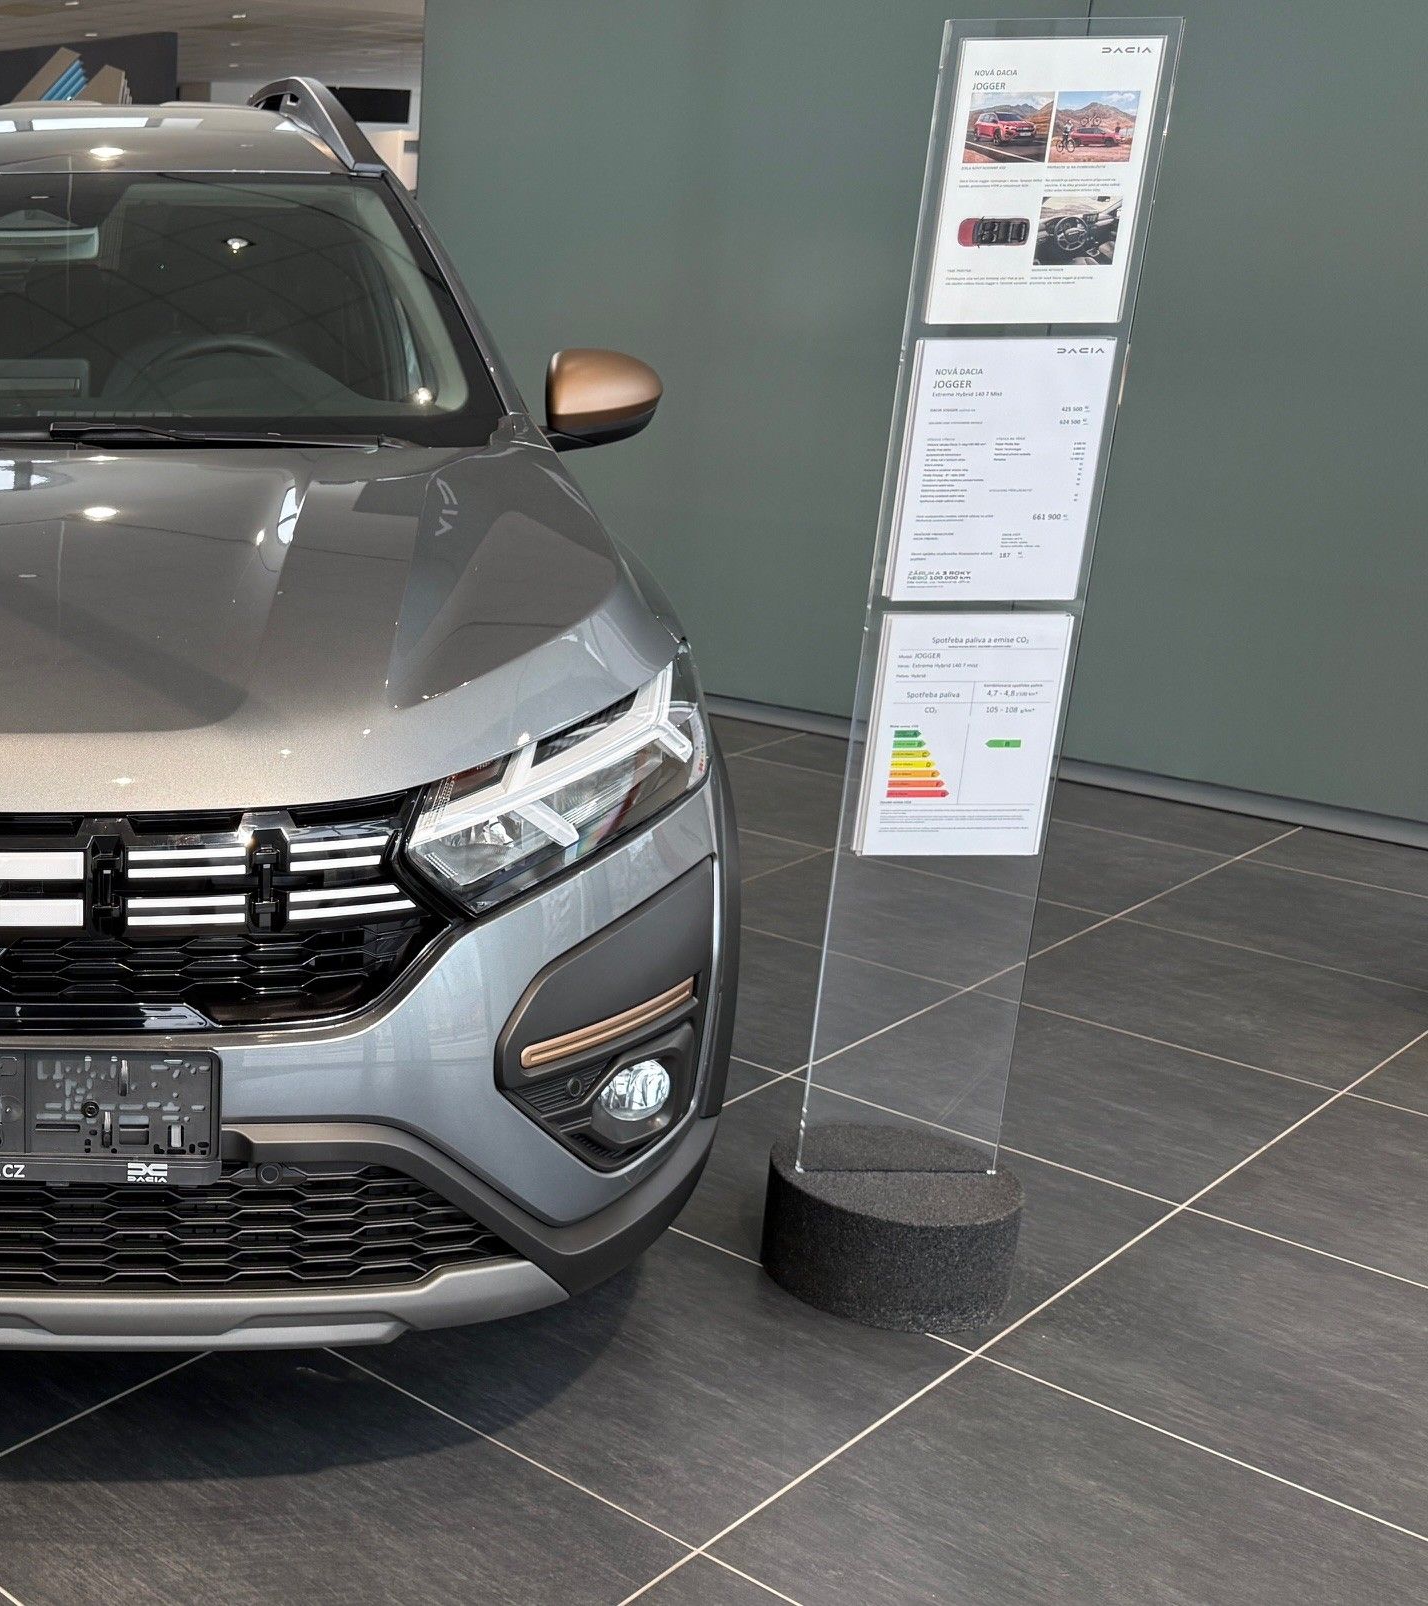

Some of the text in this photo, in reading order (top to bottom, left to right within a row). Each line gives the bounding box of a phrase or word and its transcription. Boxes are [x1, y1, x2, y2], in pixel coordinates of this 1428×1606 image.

[1101, 46, 1152, 54] DACIA
[974, 69, 995, 77] NOVÁ
[972, 82, 1006, 91] JOGGER
[935, 367, 983, 376] NOVÁ DACIA
[933, 380, 972, 389] JOGGER
[965, 636, 986, 645] paliva
[906, 690, 960, 699] Spotřeba paliva
